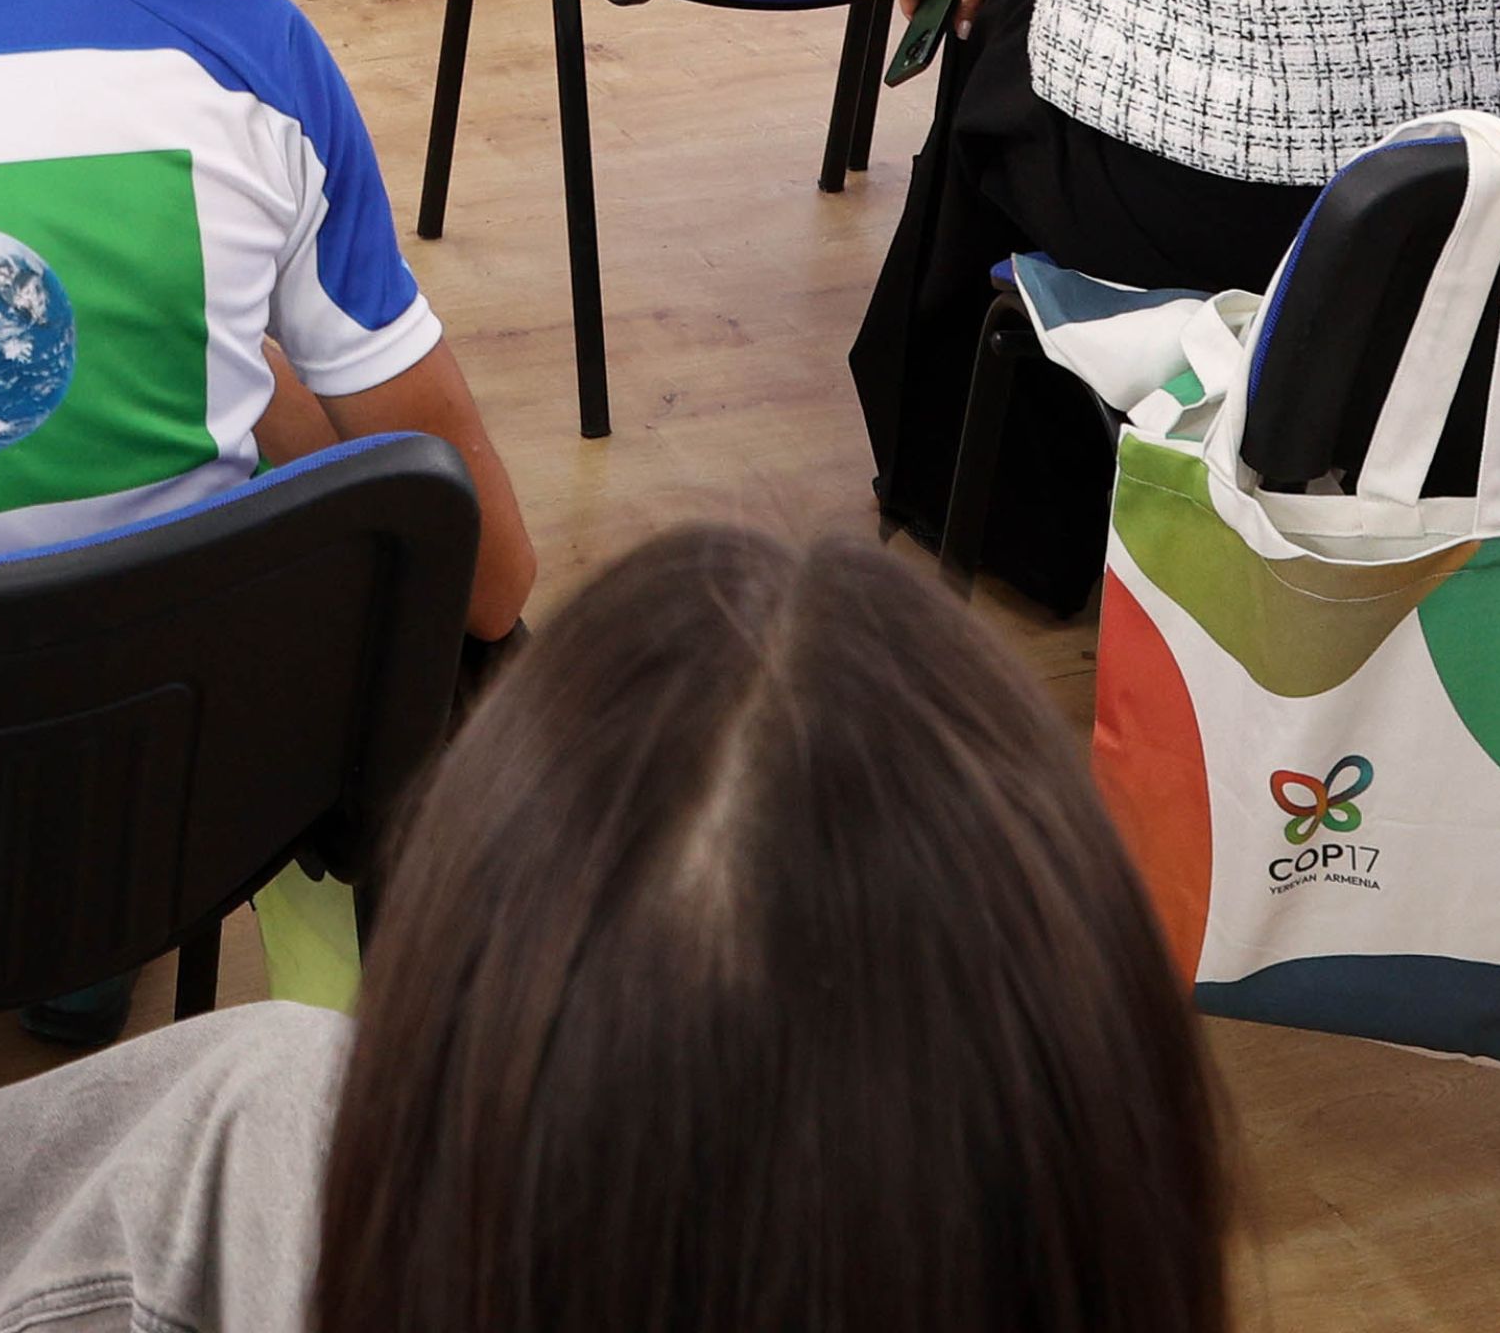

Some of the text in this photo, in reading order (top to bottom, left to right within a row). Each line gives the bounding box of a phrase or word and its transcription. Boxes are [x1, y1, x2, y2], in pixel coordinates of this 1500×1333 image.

[1268, 843, 1380, 881] COP17
[1269, 874, 1381, 895] YEREVAN ARMENIA
